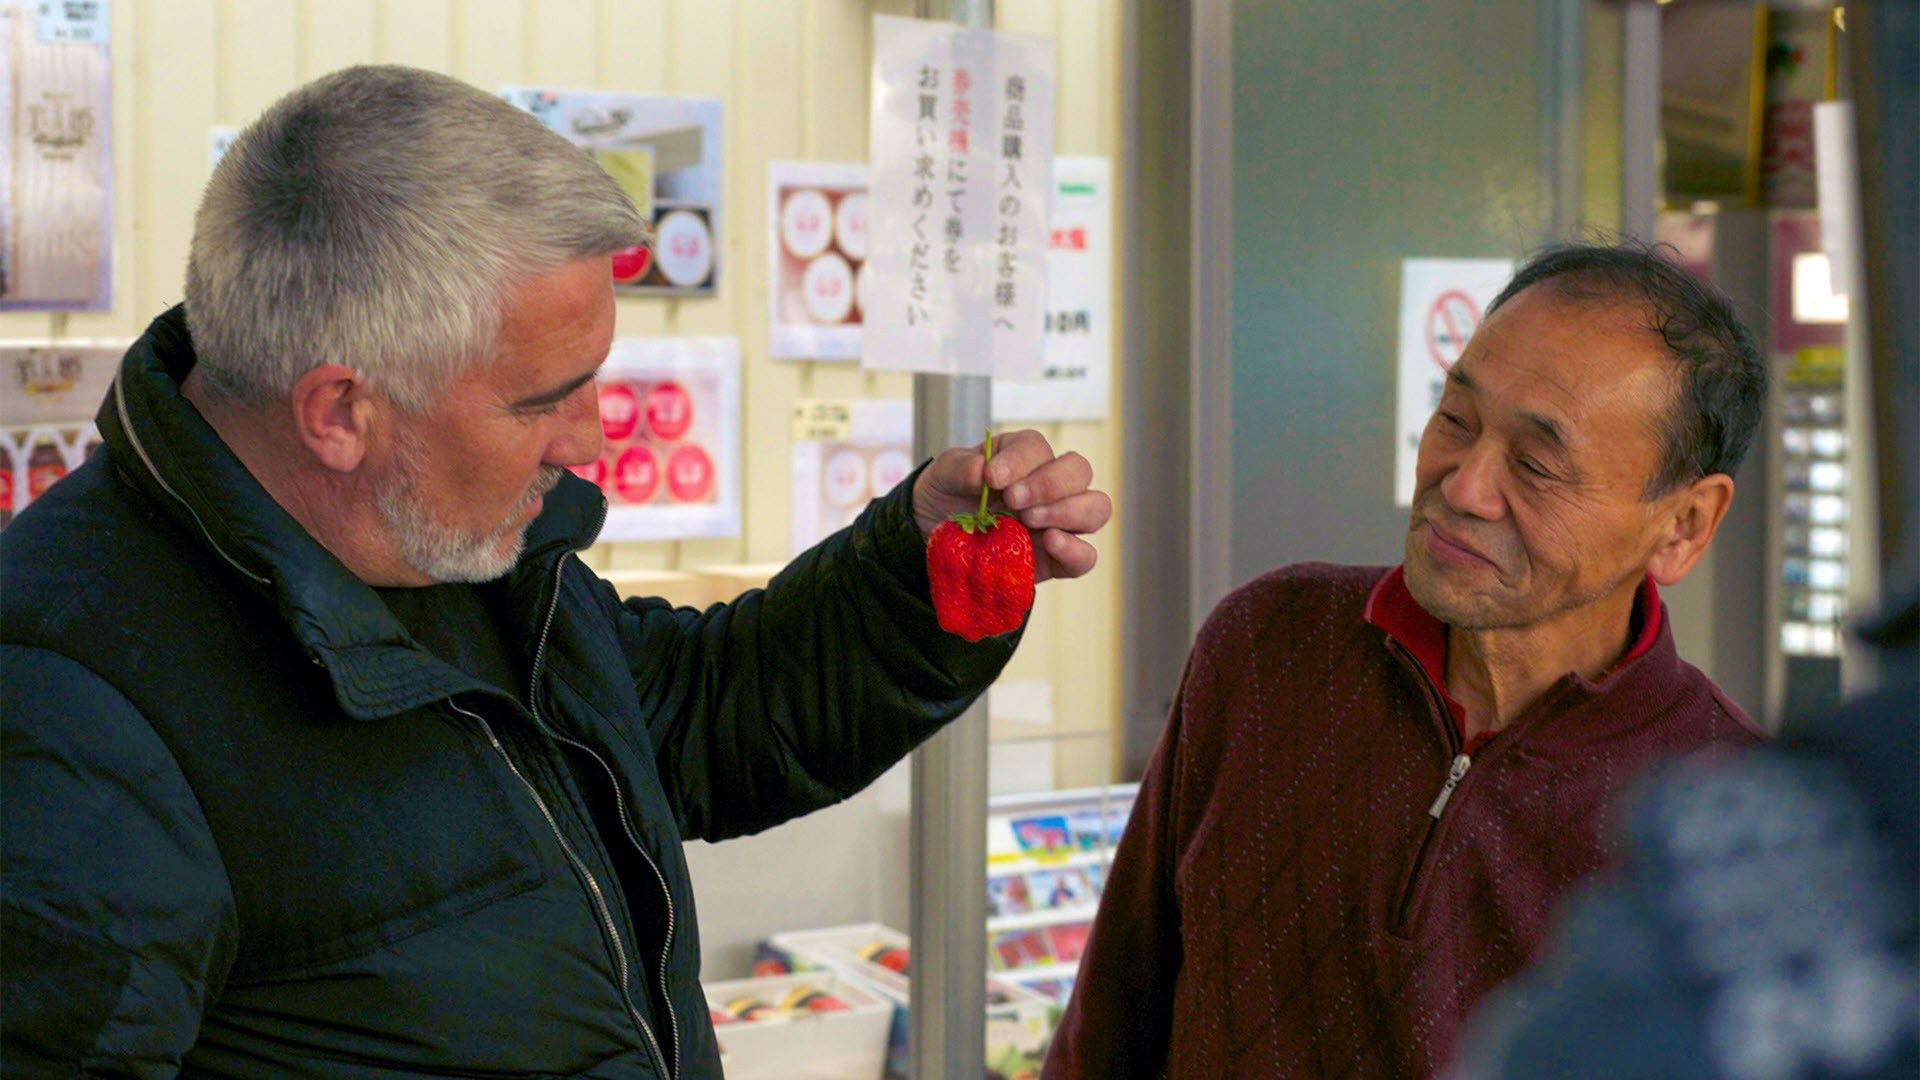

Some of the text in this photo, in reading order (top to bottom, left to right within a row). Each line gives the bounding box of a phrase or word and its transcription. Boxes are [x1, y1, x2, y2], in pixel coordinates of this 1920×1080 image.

[907, 65, 940, 326] お買い求めください
[993, 75, 1025, 330] 商品購入のお客様へ
